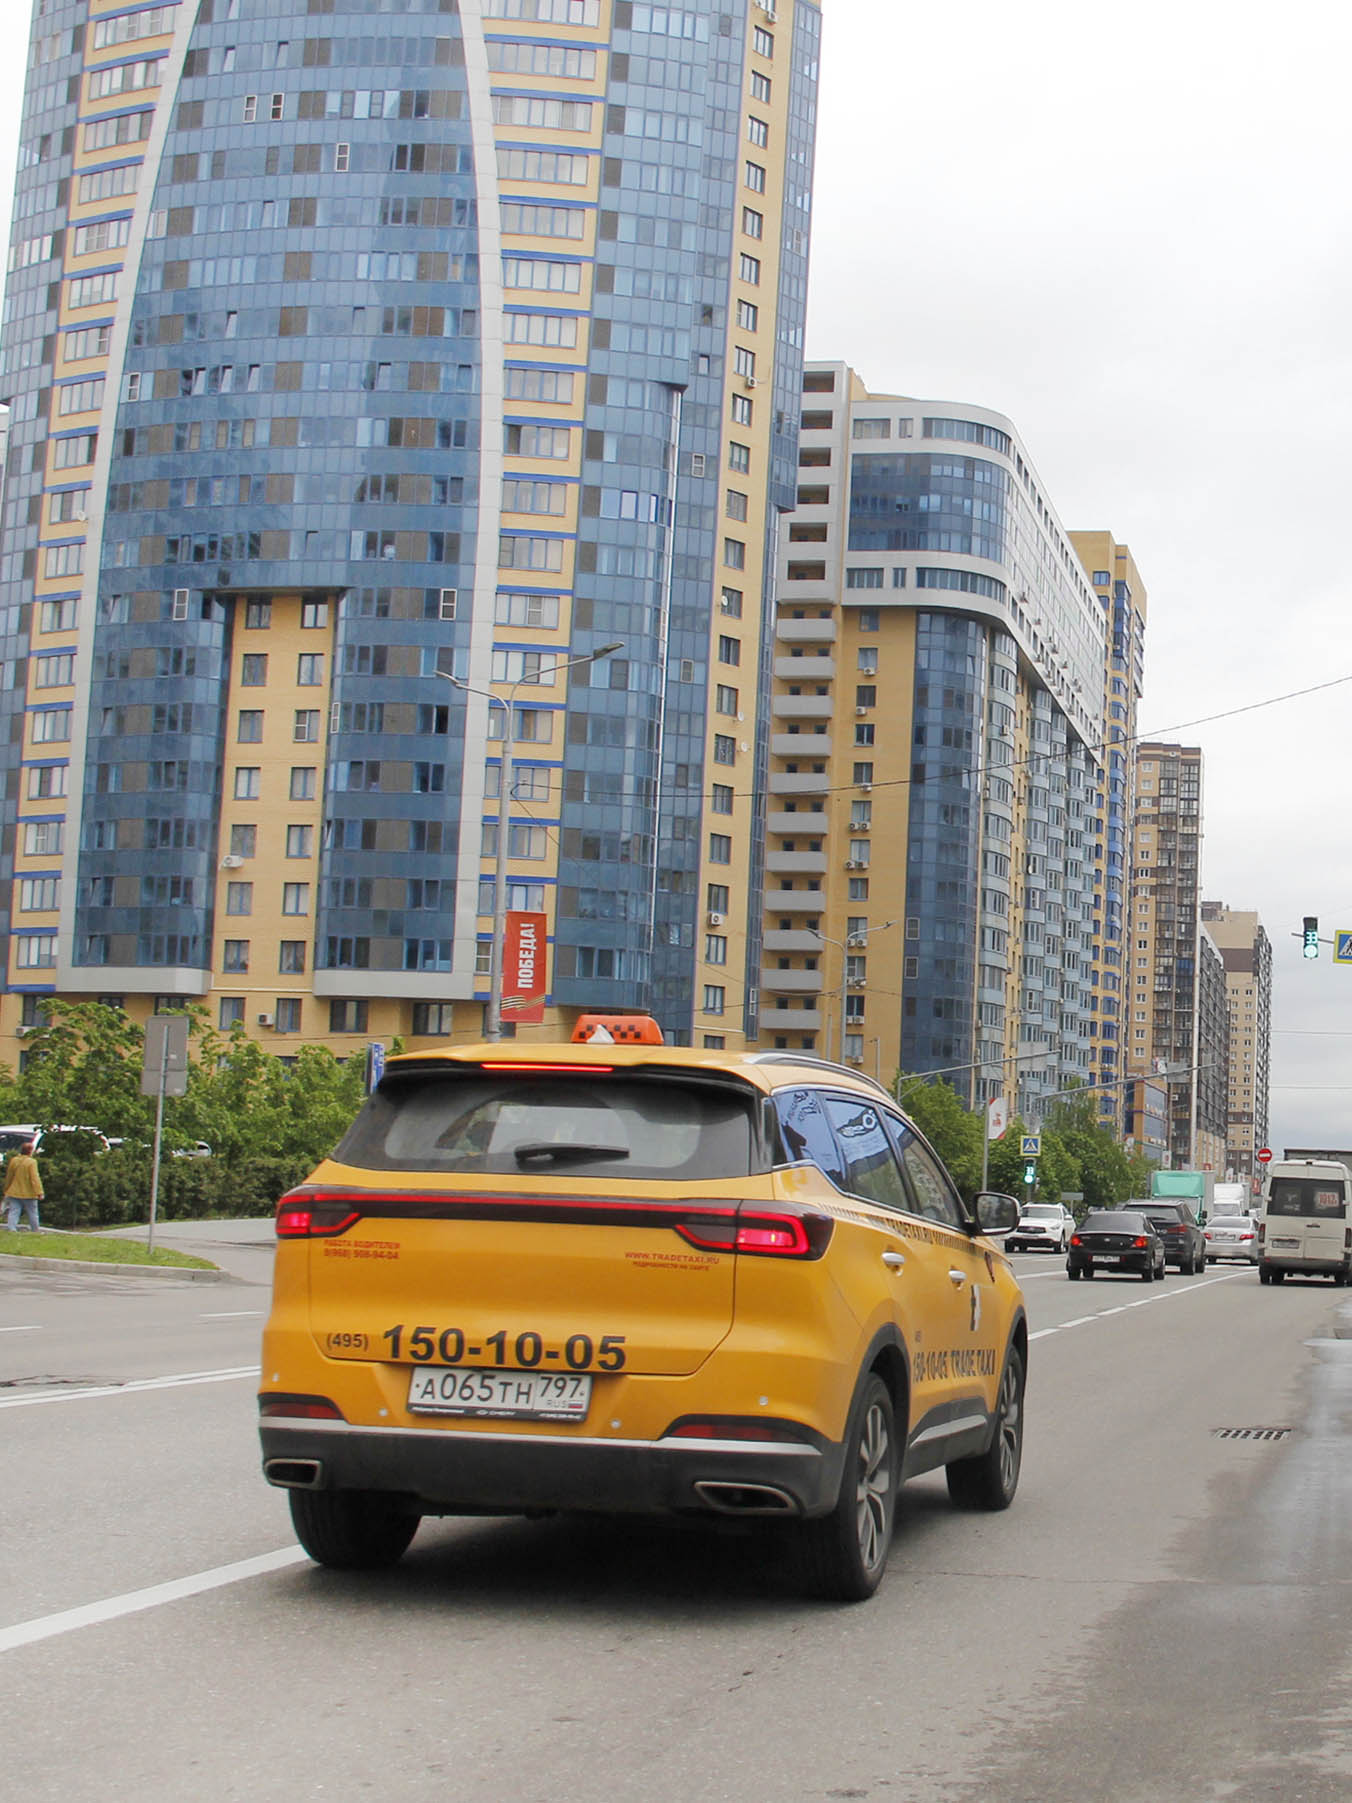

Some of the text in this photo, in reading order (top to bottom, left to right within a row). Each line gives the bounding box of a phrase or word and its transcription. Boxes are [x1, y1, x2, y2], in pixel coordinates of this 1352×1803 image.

[1306, 931, 1318, 944] 33
[517, 923, 538, 989] ПОБЕДА!
[624, 1252, 720, 1265] WWW.TRADETAXI.RU
[326, 1324, 627, 1372] (495) 150-10-05
[976, 1348, 996, 1376] TAXI
[420, 1372, 582, 1405] А065ТН 797
